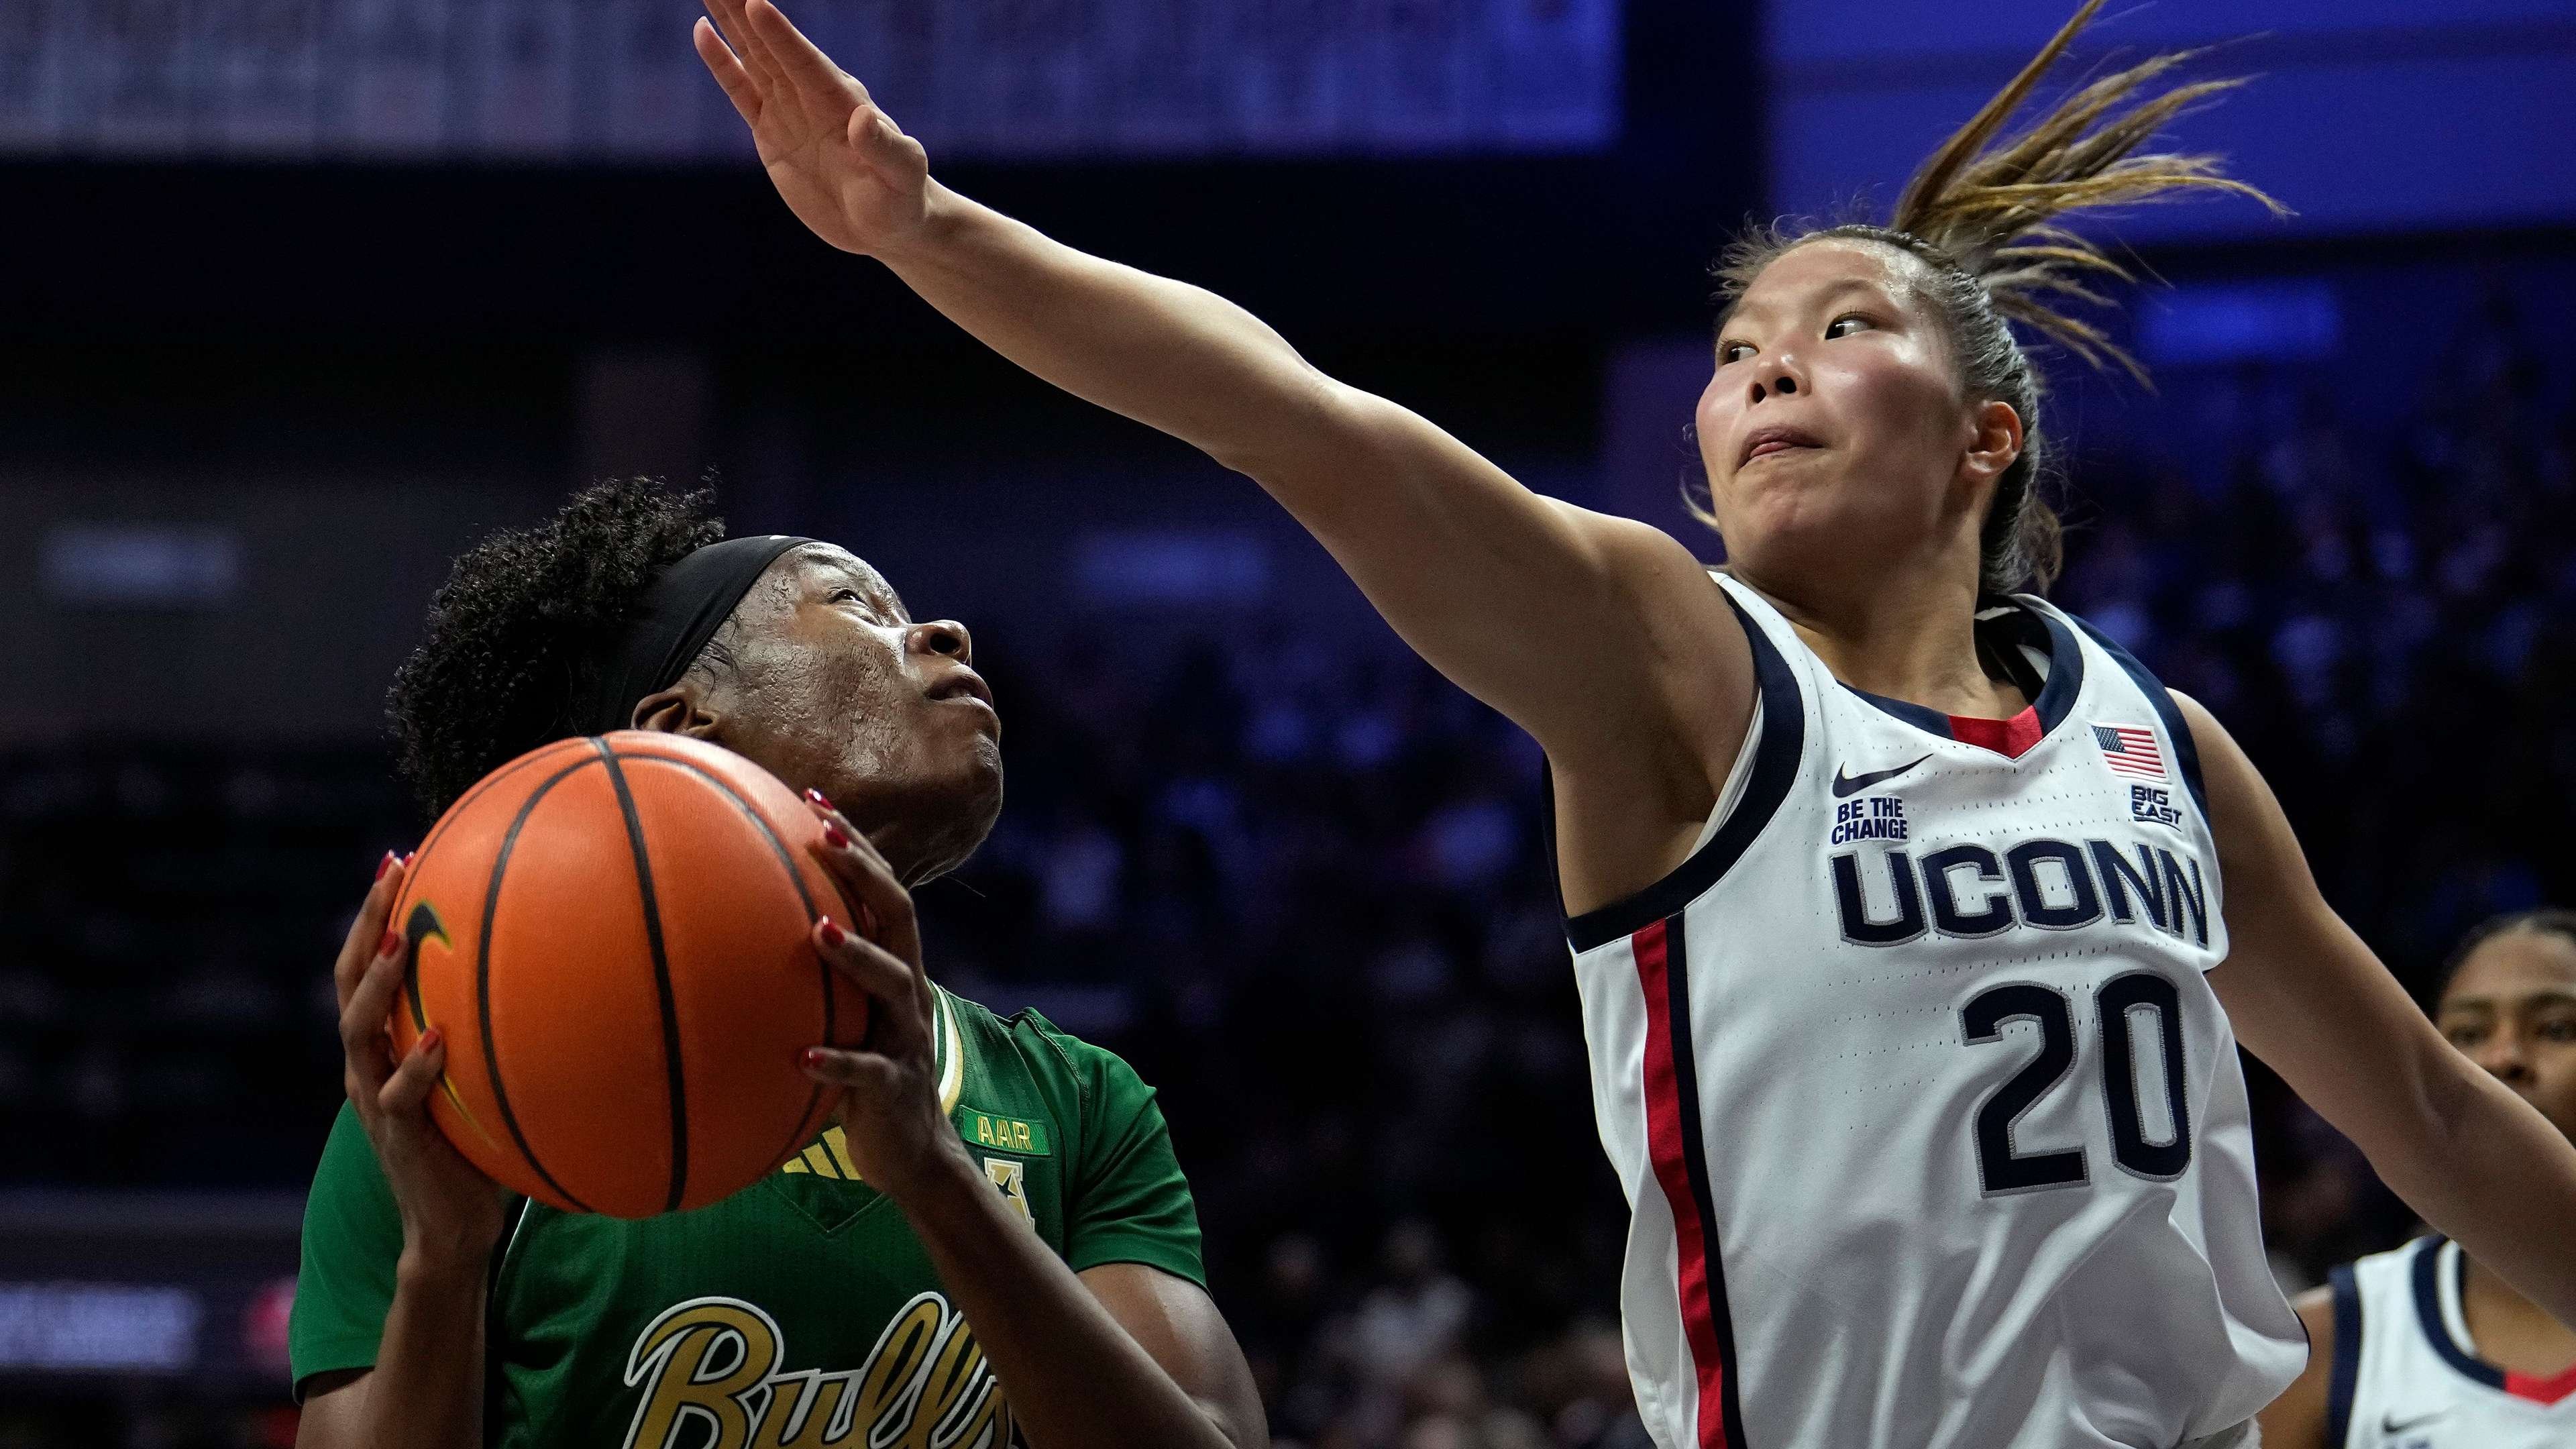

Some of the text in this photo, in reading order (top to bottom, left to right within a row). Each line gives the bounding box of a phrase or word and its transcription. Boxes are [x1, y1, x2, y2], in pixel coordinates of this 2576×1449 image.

[2131, 784, 2168, 806] BIG
[1837, 798, 1903, 824] BE THE
[2132, 800, 2182, 824] EAST
[1831, 818, 1907, 845] CHANGE
[1829, 837, 2208, 950] UCONN
[1957, 968, 2192, 1199] 20
[977, 1116, 1033, 1150] AAR
